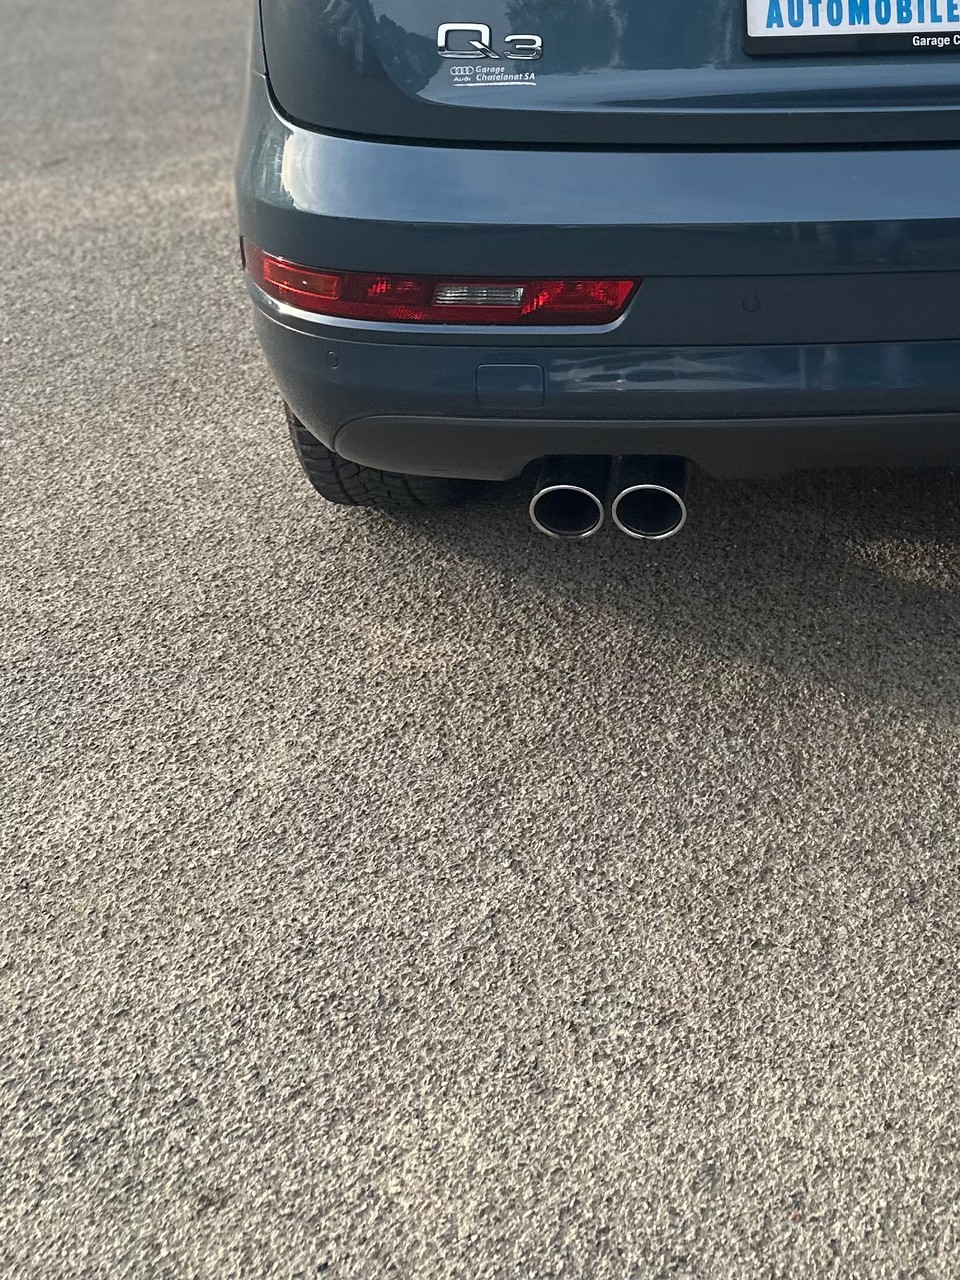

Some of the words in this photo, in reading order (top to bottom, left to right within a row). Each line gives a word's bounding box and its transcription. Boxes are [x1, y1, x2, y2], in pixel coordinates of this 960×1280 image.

[437, 22, 543, 60] Q3
[912, 34, 951, 48] Garage
[475, 65, 506, 75] Garage
[475, 73, 523, 82] Chatelanat
[524, 72, 536, 81] SA
